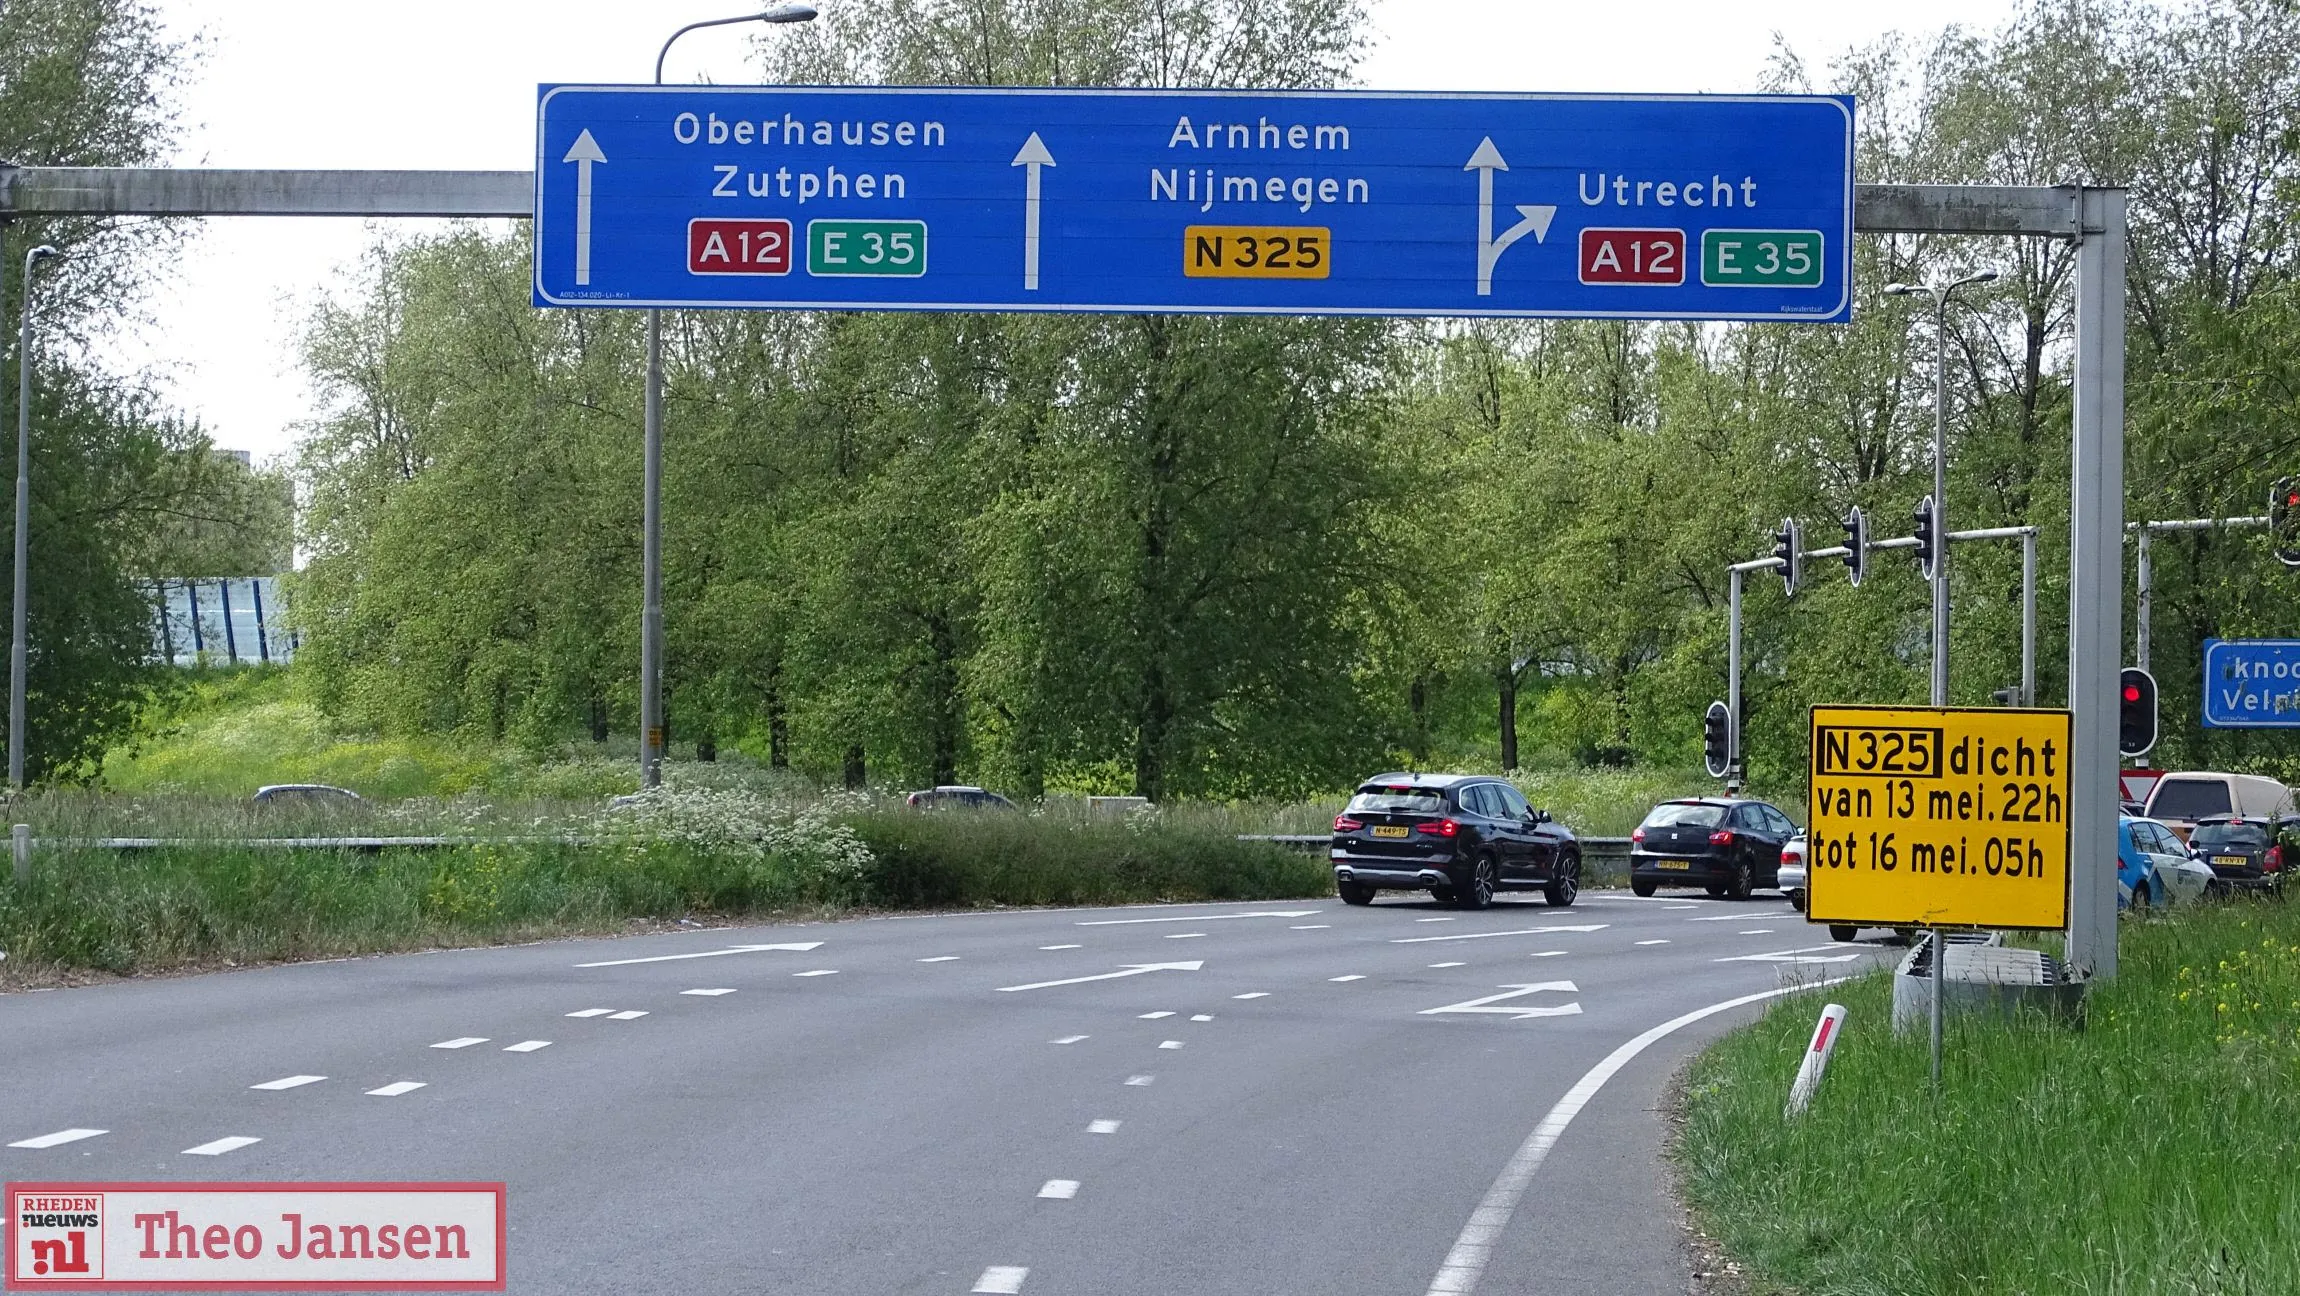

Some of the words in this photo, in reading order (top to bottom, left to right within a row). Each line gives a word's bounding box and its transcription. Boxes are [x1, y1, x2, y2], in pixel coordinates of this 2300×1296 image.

[674, 112, 945, 146] Oberhausen
[1168, 116, 1350, 150] Arnhem
[712, 165, 905, 204] Zutphen
[1151, 168, 1369, 213] Nijmegen
[1579, 173, 1757, 208] Utrecht
[699, 230, 782, 264] A12
[1590, 240, 1675, 273] A12
[1950, 735, 2056, 777] dicht
[1817, 787, 1872, 818] van
[1886, 779, 1915, 819] 13
[1375, 826, 1407, 837] N-449-TS
[1813, 830, 1857, 869] tot
[1869, 832, 1898, 871] 16
